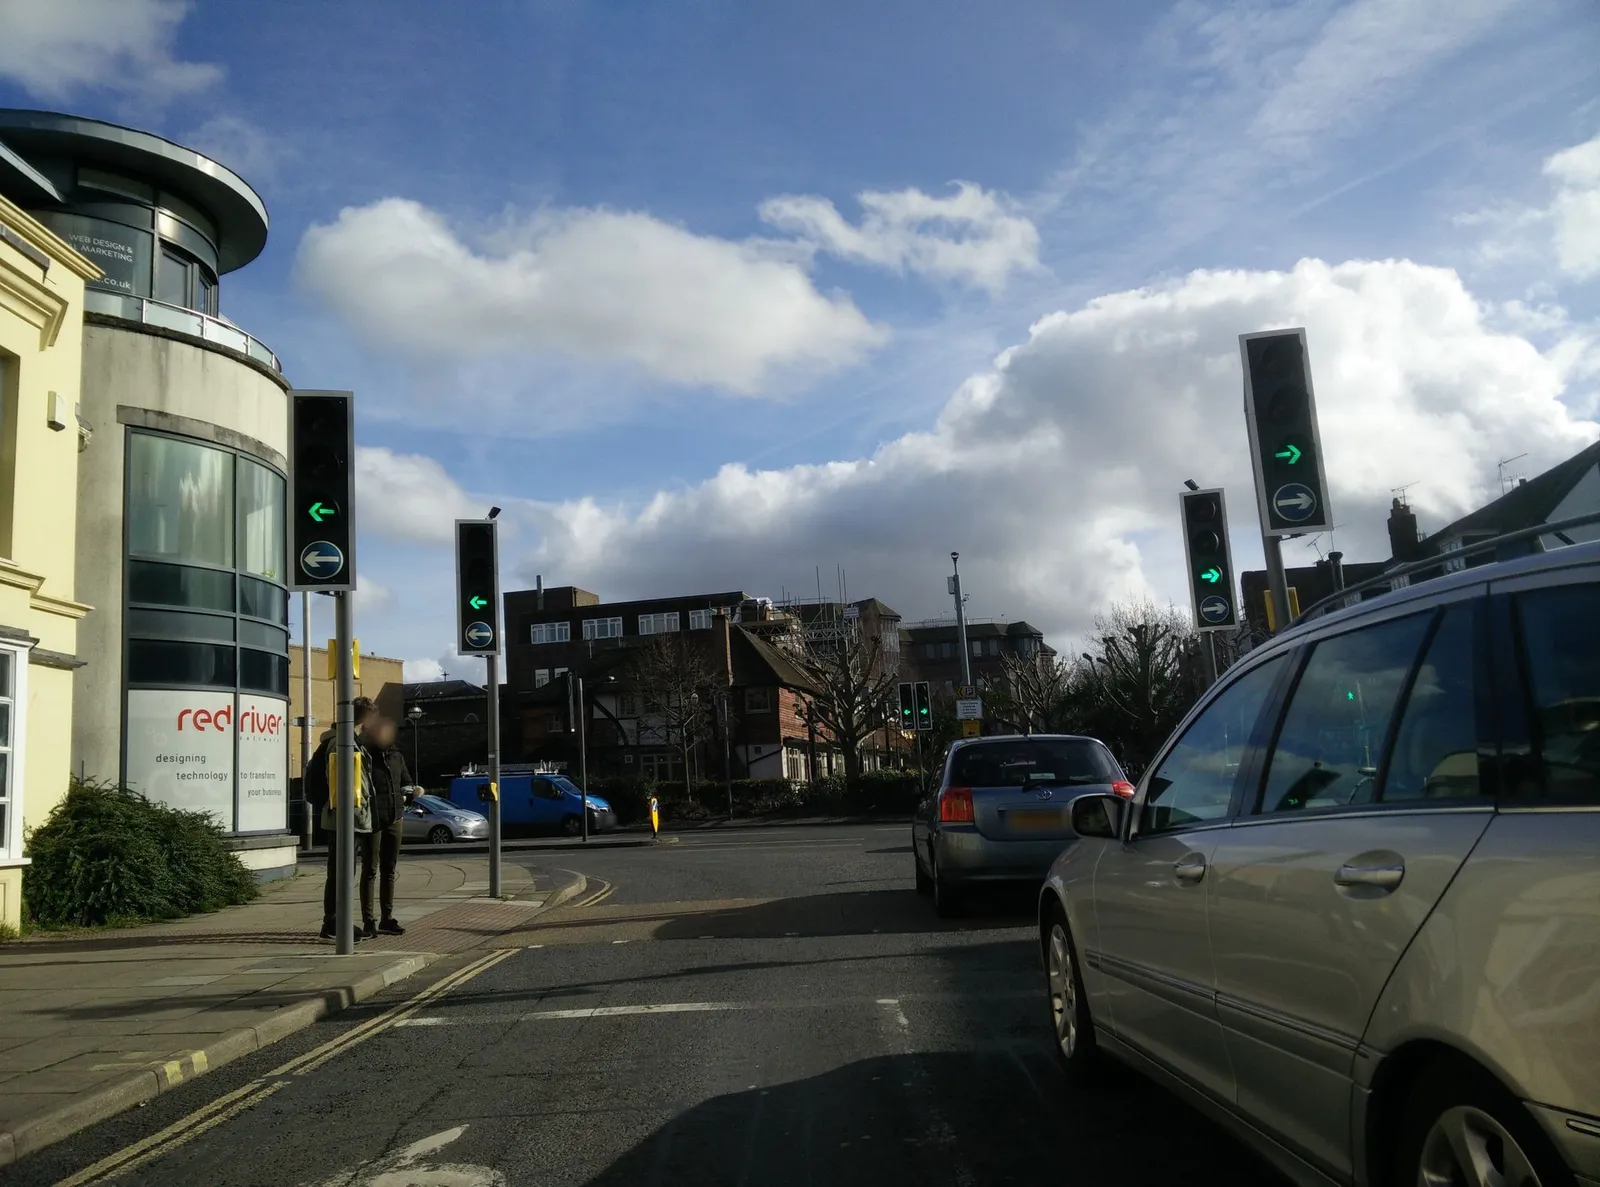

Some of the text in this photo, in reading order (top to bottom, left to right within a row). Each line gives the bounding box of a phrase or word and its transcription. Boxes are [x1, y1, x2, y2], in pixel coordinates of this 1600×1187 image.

[69, 233, 133, 254] WEB DESIGN &
[81, 245, 133, 262] MARKETING
[155, 753, 206, 764] designing
[176, 770, 276, 781] technology to transform
[247, 787, 282, 798] your business
